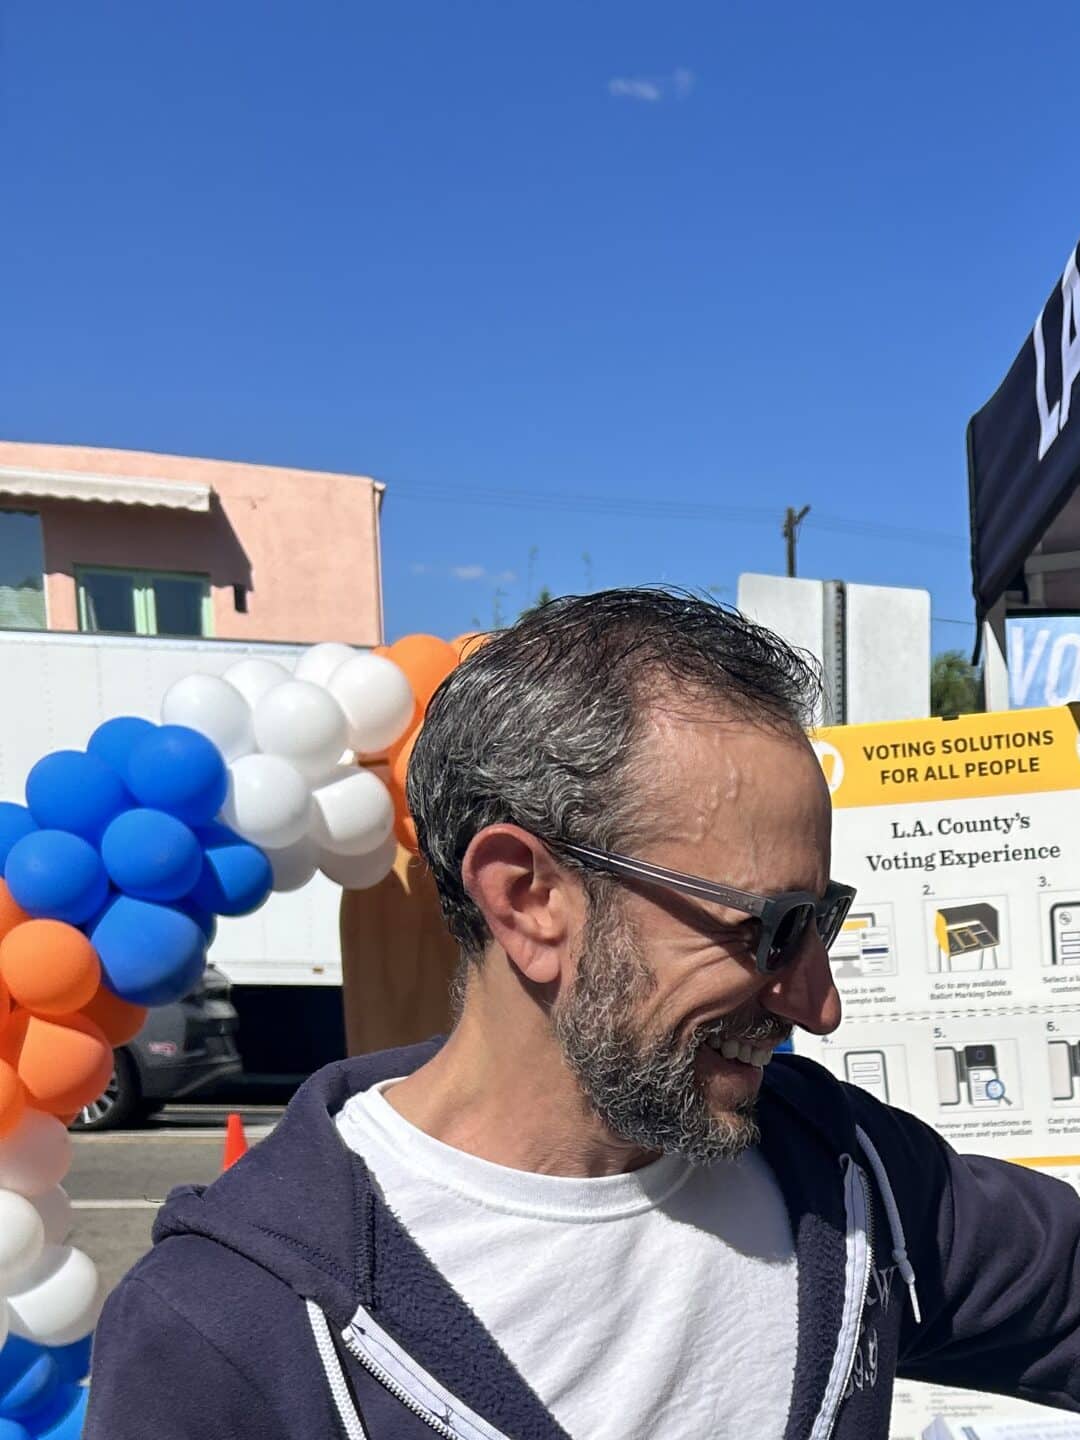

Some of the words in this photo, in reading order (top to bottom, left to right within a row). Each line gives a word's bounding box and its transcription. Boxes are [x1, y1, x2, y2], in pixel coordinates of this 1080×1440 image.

[863, 741, 936, 761] VOTING
[941, 730, 1054, 754] SOLUTIONS
[880, 767, 919, 785] FOR
[924, 764, 960, 781] ALL
[965, 757, 1040, 777] PEOPLE
[891, 820, 933, 839] L.A.
[866, 852, 936, 872] Voting
[939, 844, 1061, 868] Experience
[922, 883, 936, 896] 2.
[1038, 876, 1051, 888] 3.
[934, 1027, 947, 1038] 5.
[1047, 1021, 1060, 1032] 6.
